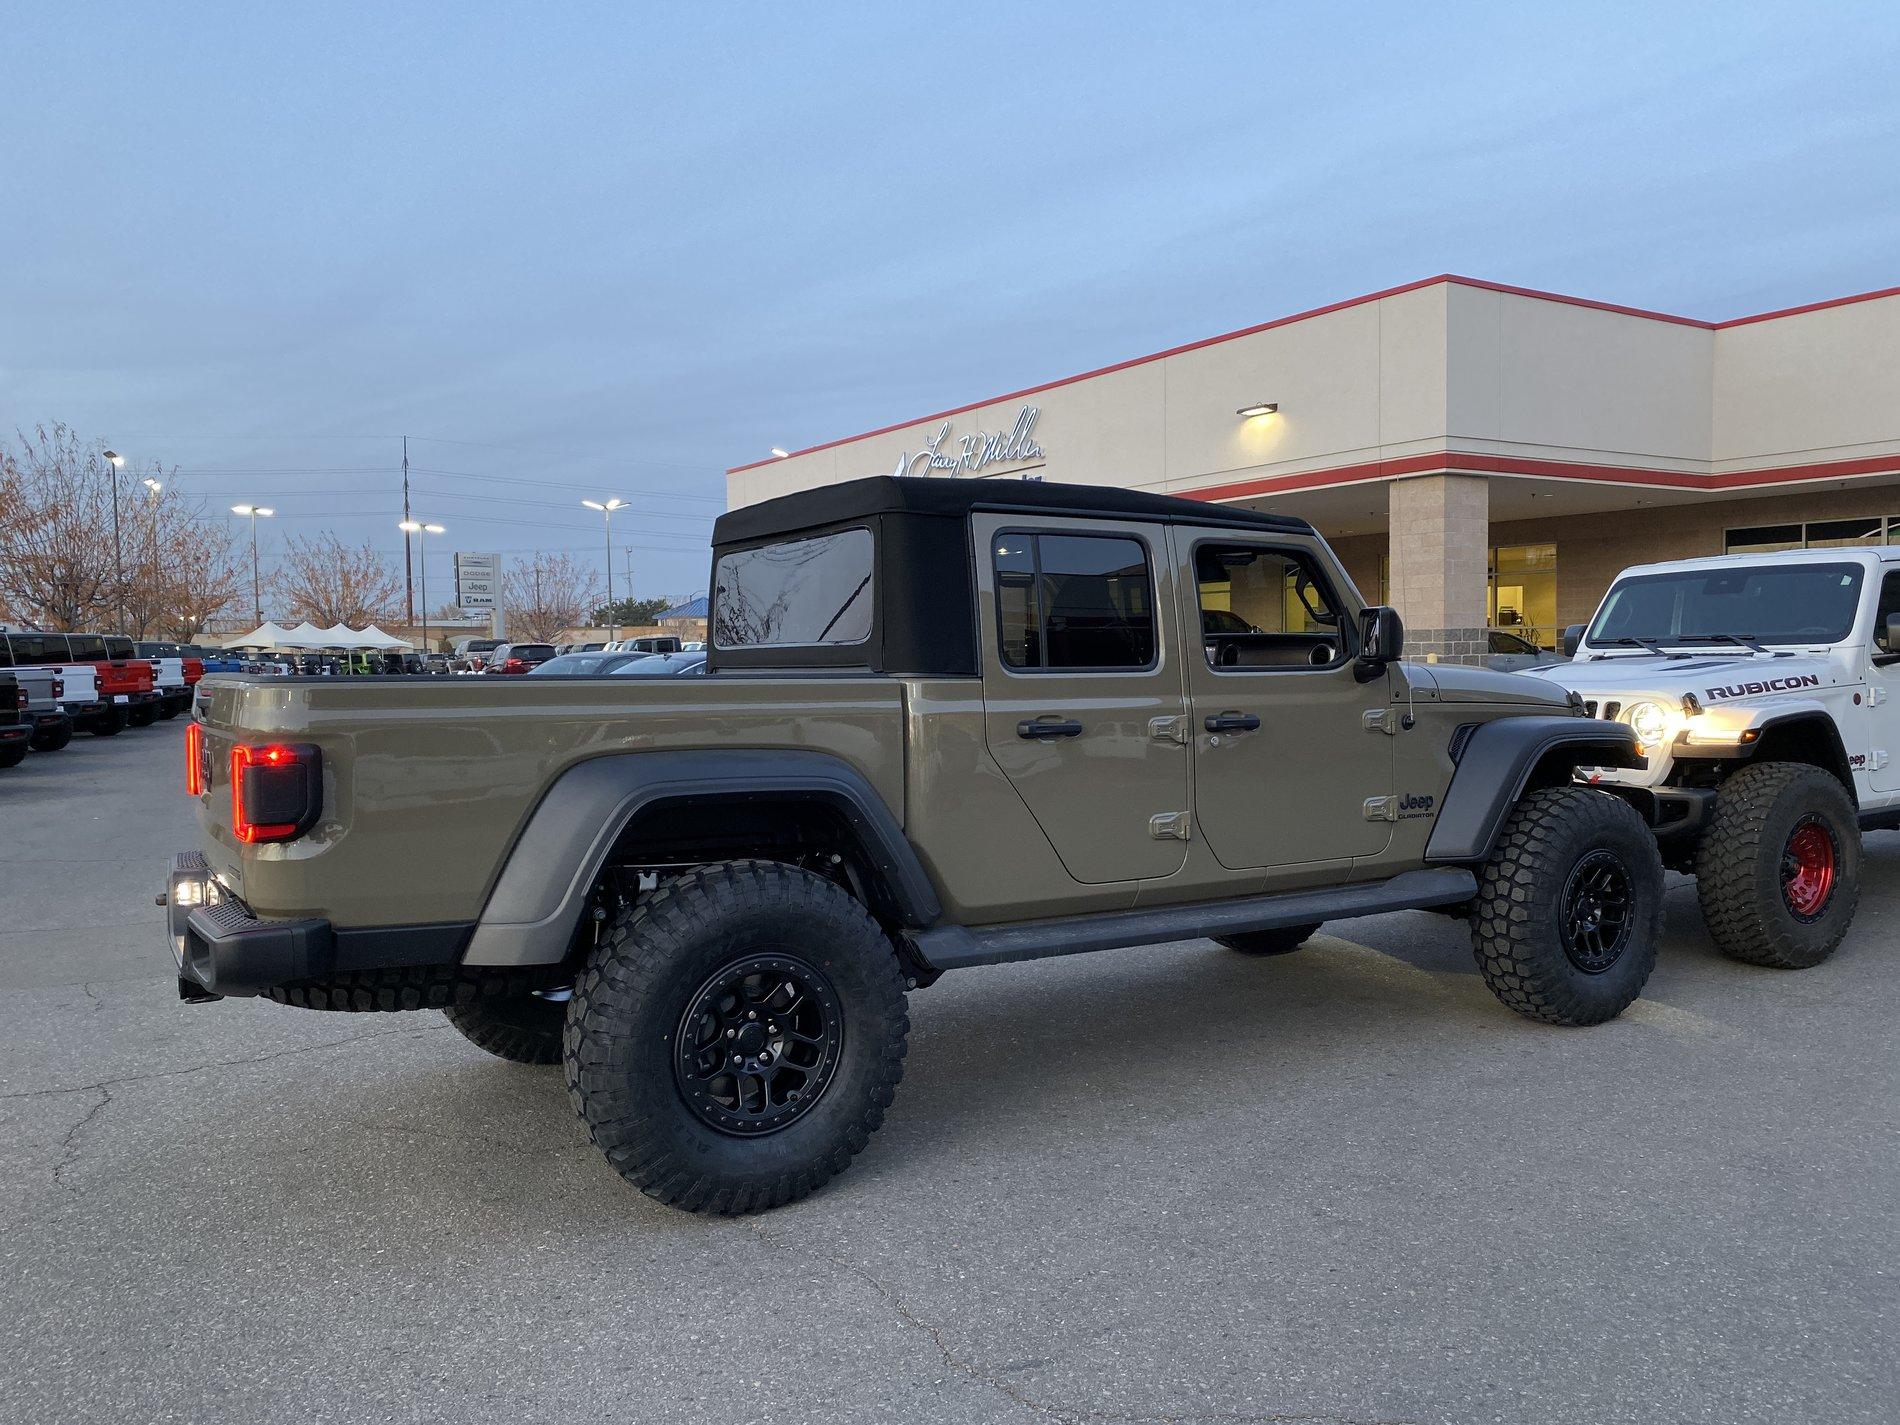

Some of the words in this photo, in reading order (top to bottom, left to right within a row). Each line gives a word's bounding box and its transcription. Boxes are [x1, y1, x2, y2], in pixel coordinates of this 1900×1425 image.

[468, 582, 488, 591] Jeep
[1705, 674, 1820, 700] RUBICON
[1848, 754, 1866, 766] eep
[1399, 793, 1434, 811] Jeep
[1398, 812, 1435, 820] GLADIATOR
